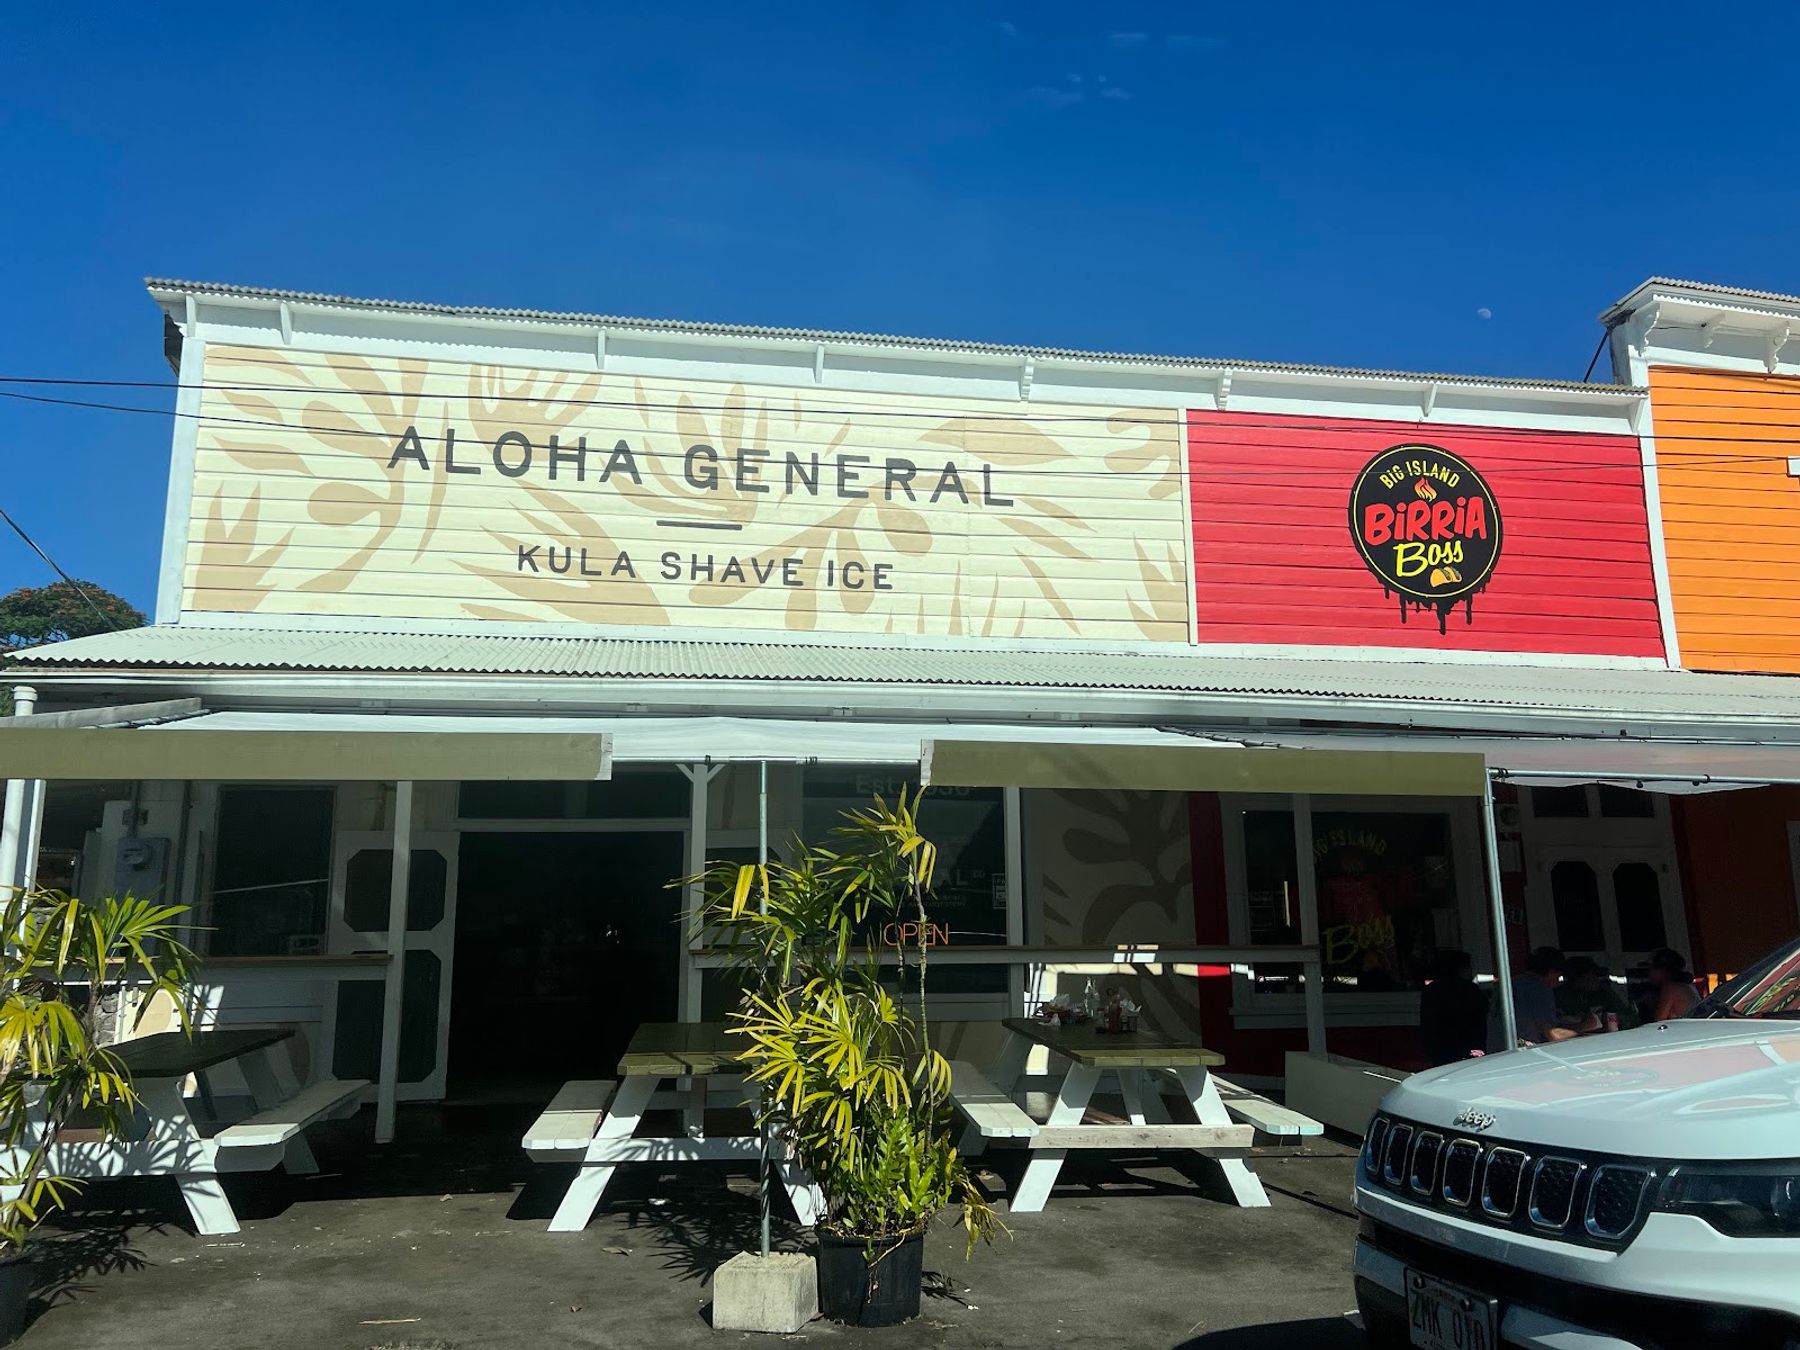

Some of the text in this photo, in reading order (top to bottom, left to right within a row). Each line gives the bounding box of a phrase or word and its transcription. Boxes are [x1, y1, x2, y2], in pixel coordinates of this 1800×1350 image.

[387, 425, 1014, 508] ALOHA GENERAL
[1379, 460, 1461, 489] BIG ISLAND
[517, 543, 893, 591] KULA SHAVE ICE
[1393, 540, 1464, 577] Boss
[884, 922, 949, 946] OPEN
[1456, 1106, 1497, 1130] Jeep
